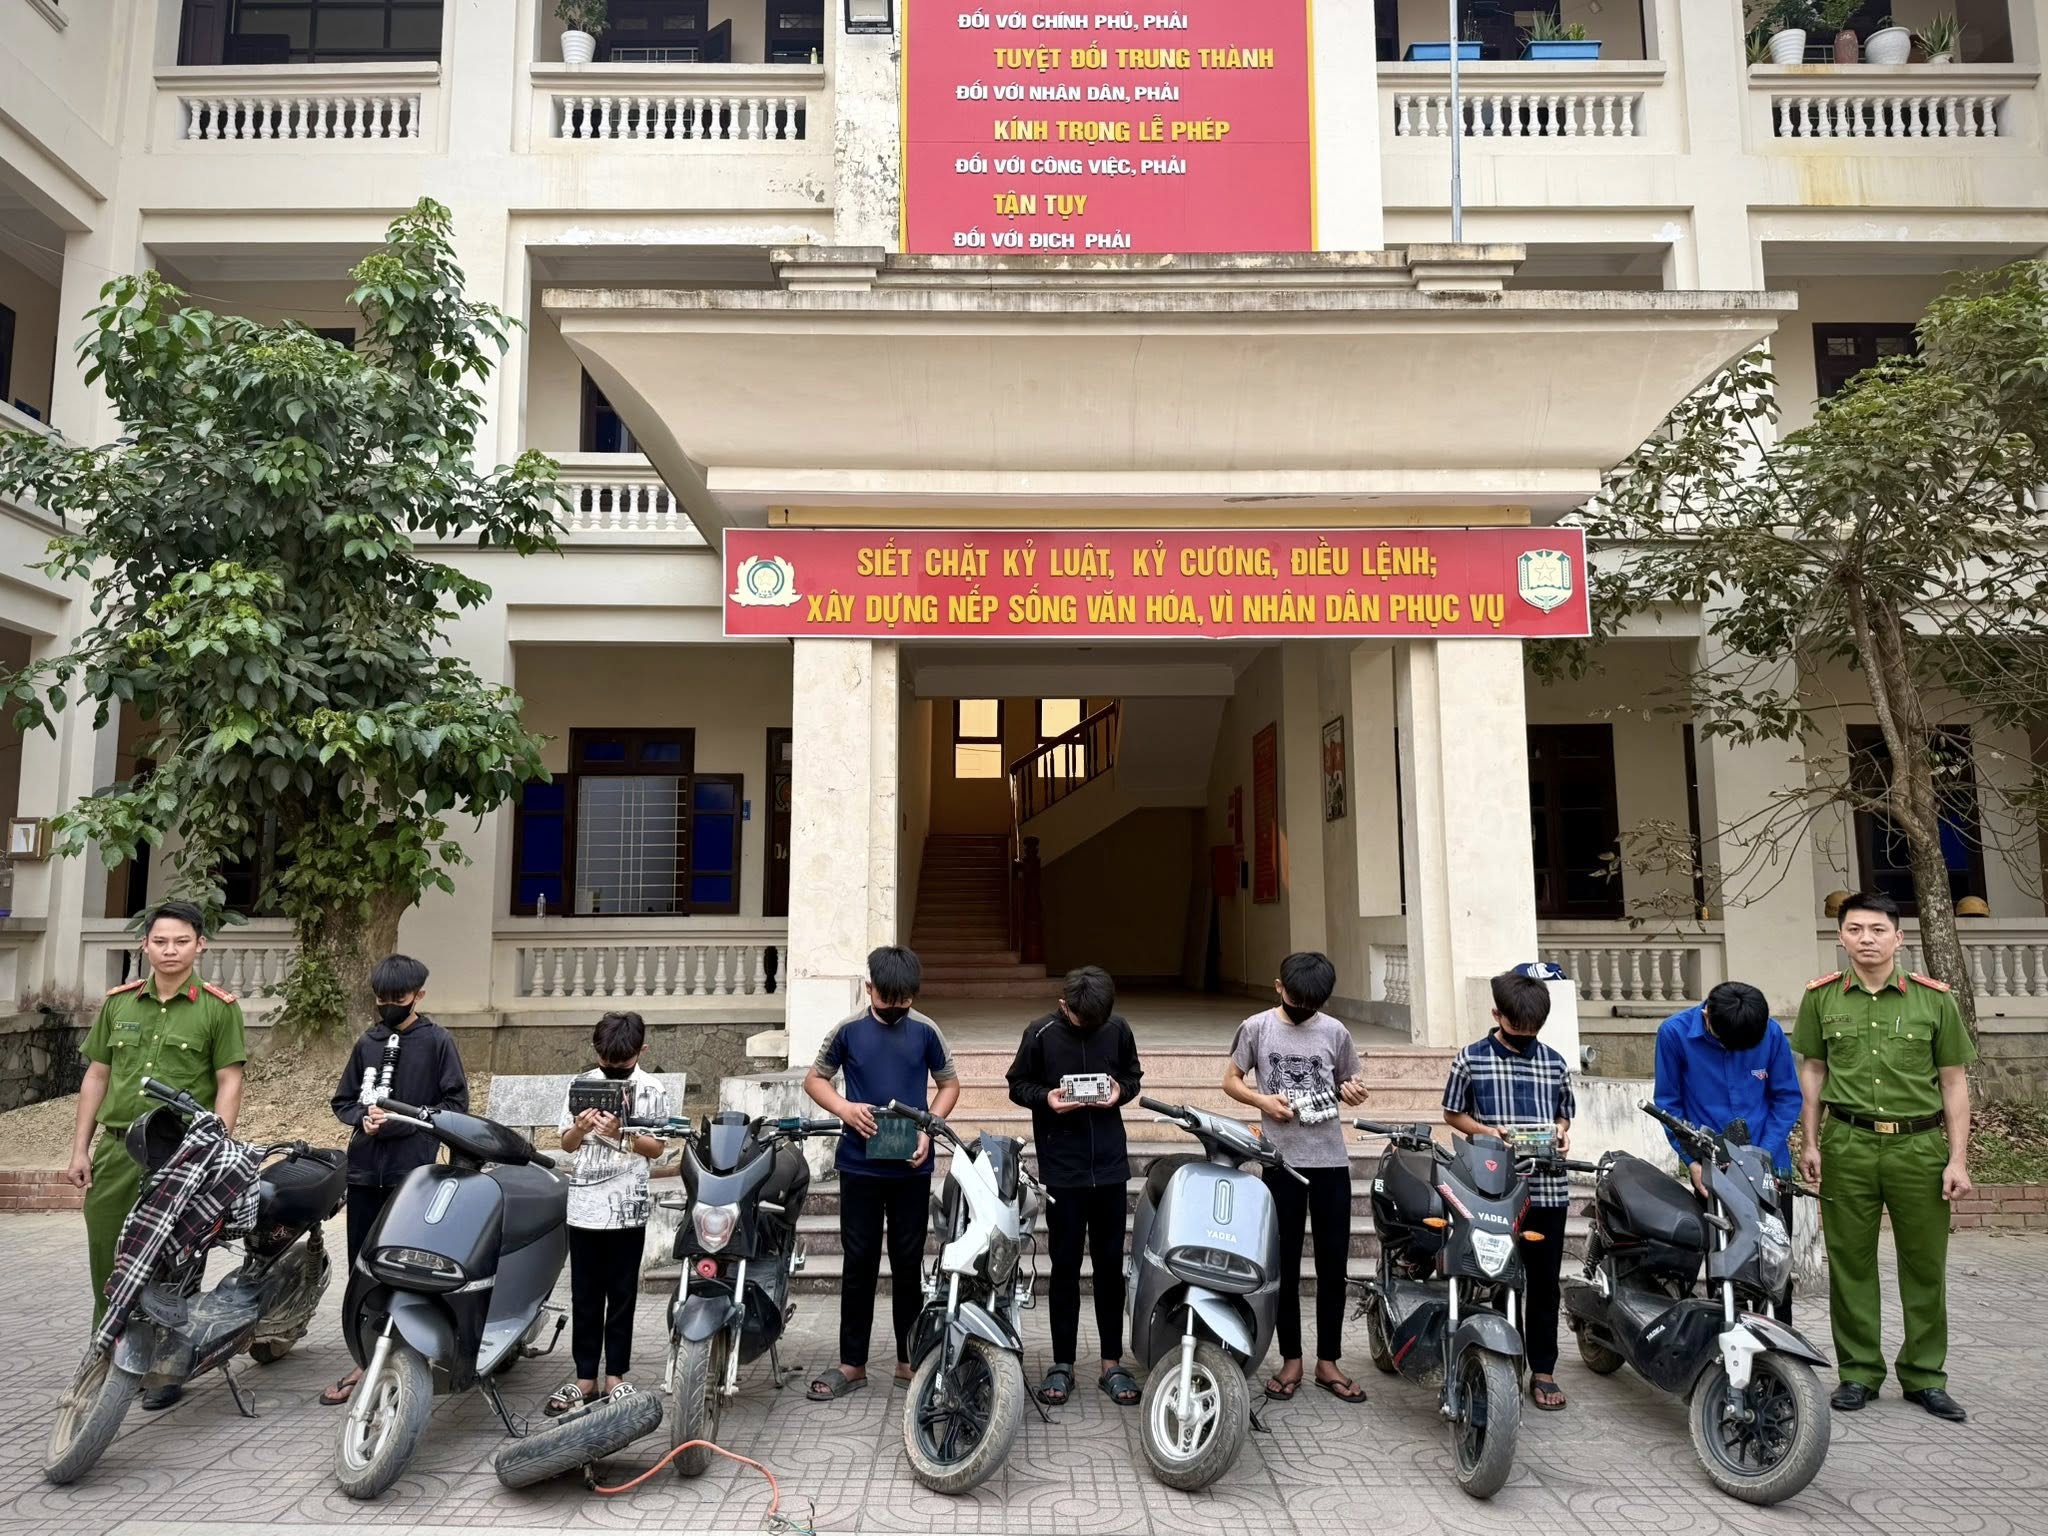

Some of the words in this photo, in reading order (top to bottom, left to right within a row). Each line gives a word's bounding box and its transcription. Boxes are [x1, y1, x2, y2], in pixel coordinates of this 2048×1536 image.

[957, 8, 990, 29] ĐỐI
[995, 10, 1027, 29] VỚI
[1031, 10, 1089, 29] CHÍNH
[1094, 10, 1139, 31] PHỦ,
[1143, 10, 1188, 29] PHẢI
[993, 43, 1062, 73] TUYỆT
[1069, 39, 1108, 69] ĐỐI
[1115, 47, 1191, 69] TRUNG
[1198, 44, 1275, 69] THÀNH
[955, 81, 988, 101] ĐỐI
[993, 81, 1025, 101] VỚI
[1029, 83, 1081, 101] NHÂN
[1087, 83, 1131, 103] DÂN,
[1134, 82, 1180, 101] PHẢI
[994, 114, 1049, 141] KÍNH
[1056, 119, 1131, 146] TRỌNG
[1138, 113, 1164, 141] LỄ
[1171, 116, 1231, 141] PHÉP
[954, 152, 988, 174] ĐỐI
[993, 154, 1026, 174] VỚI
[1030, 156, 1083, 174] CÔNG
[1087, 155, 1137, 178] VIỆC,
[1140, 154, 1187, 174] PHẢI
[993, 189, 1036, 219] TẬN
[1044, 194, 1088, 220] TỤY
[952, 225, 986, 248] ĐỐI
[991, 228, 1024, 248] VỚI
[1028, 233, 1075, 251] ĐỊCH
[1085, 230, 1131, 248] PHẢI
[857, 537, 912, 576] SIẾT
[925, 543, 990, 581] CHẶT
[1003, 538, 1037, 576] KỶ
[1050, 543, 1115, 581] LUẬT,
[1133, 539, 1167, 576] KỶ
[1180, 544, 1279, 579] CƯƠNG,
[1290, 536, 1349, 576] ĐIỀU
[1362, 541, 1437, 581] LỆNH;
[807, 589, 855, 622] XÂY
[866, 592, 938, 628] DỰNG
[948, 584, 999, 623] NẾP
[1009, 583, 1077, 623] SỐNG
[1087, 589, 1136, 623] VĂN
[1146, 589, 1204, 626] HÓA,
[1210, 589, 1233, 622] VÌ
[1242, 589, 1316, 622] NHÂN
[1325, 588, 1380, 622] DÂN
[1390, 593, 1460, 628] PHỤC
[1469, 593, 1505, 628] VỤ
[1477, 1212, 1510, 1226] YADEA
[1206, 1228, 1238, 1245] YADEA
